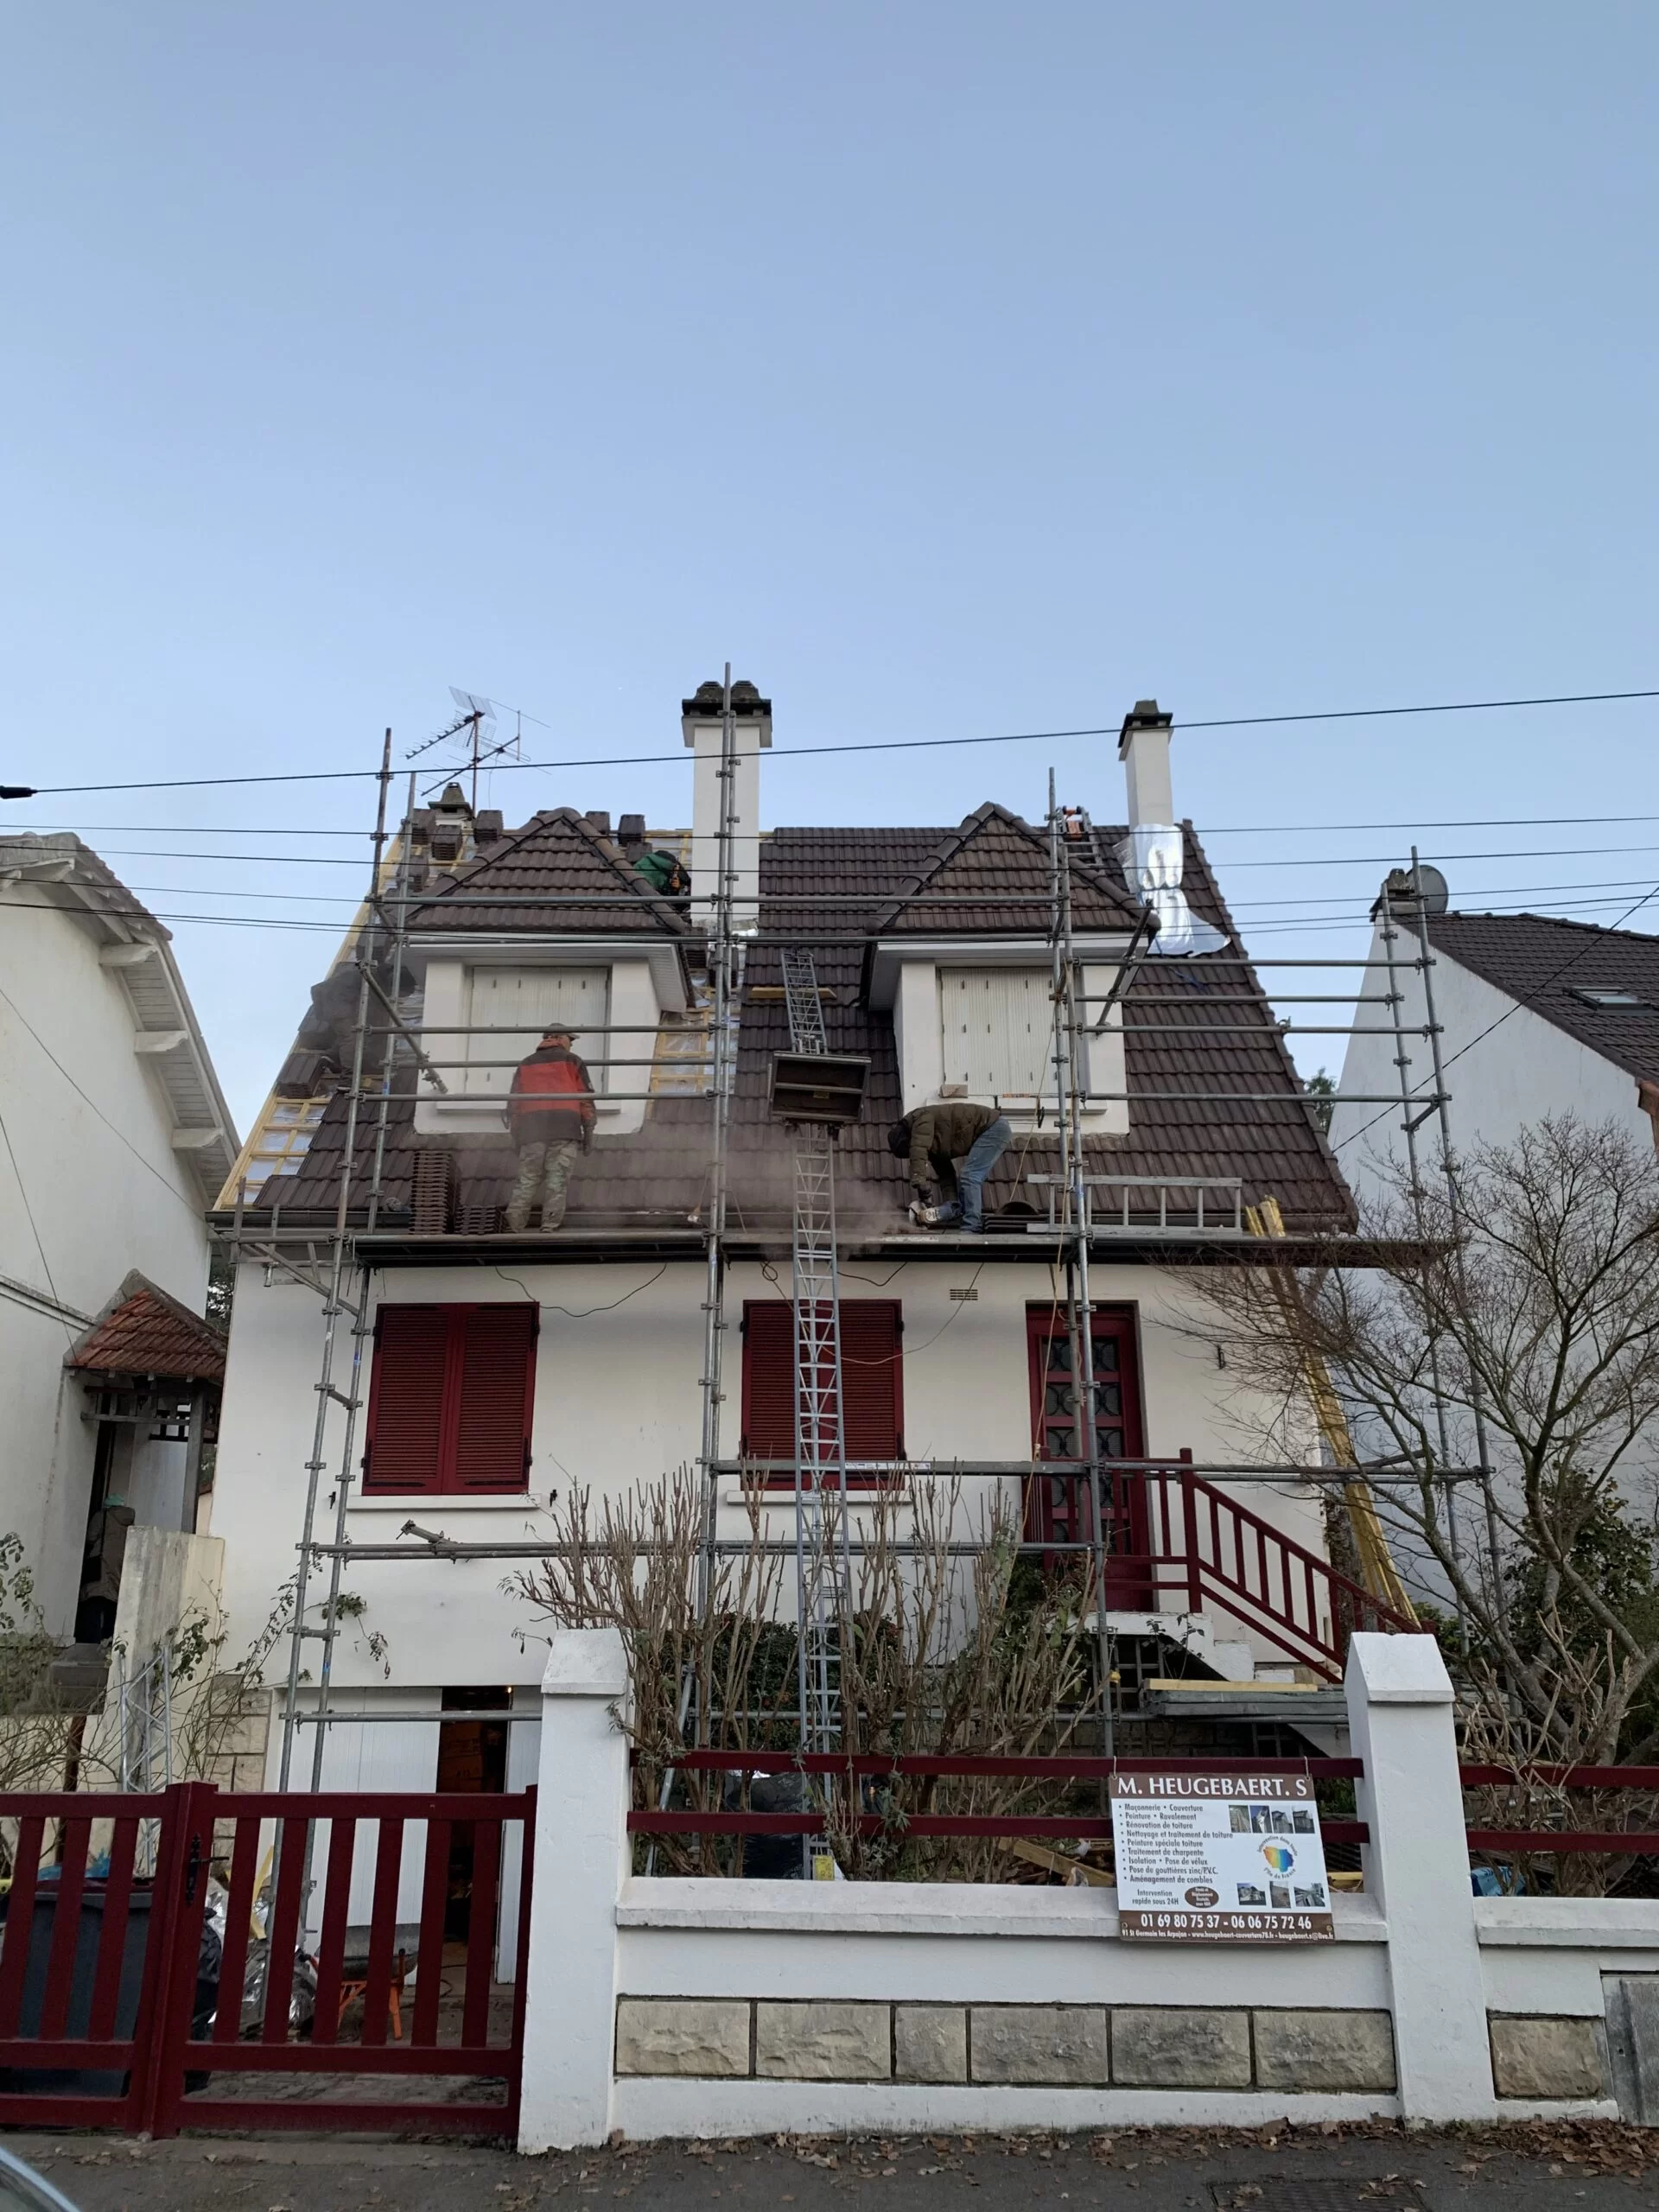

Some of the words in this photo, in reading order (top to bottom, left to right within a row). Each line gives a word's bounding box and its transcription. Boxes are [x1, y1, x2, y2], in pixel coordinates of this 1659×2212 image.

[1118, 1777, 1142, 1795] M.
[1149, 1777, 1290, 1796] HEUGEBAERT.
[1296, 1779, 1307, 1796] S
[1124, 1803, 1160, 1813] Maçonnerie
[1127, 1830, 1159, 1839] Nettoyage
[1154, 1839, 1181, 1848] spéciale
[1128, 1847, 1161, 1856] Traitement
[1172, 1848, 1205, 1858] charpente
[1128, 1856, 1157, 1865] Isolation
[1181, 1857, 1190, 1866] de
[1145, 1866, 1154, 1874] de
[1129, 1874, 1176, 1884] Aménagement
[1177, 1875, 1186, 1884] de
[1141, 1914, 1154, 1928] 01
[1158, 1914, 1171, 1928] 69
[1173, 1915, 1188, 1929] 80
[1190, 1915, 1205, 1929] 75
[1206, 1915, 1220, 1929] 37
[1230, 1915, 1245, 1929] 06
[1248, 1916, 1262, 1929] 06
[1264, 1916, 1279, 1929] 75
[1281, 1916, 1295, 1929] 72
[1298, 1916, 1313, 1929] 46
